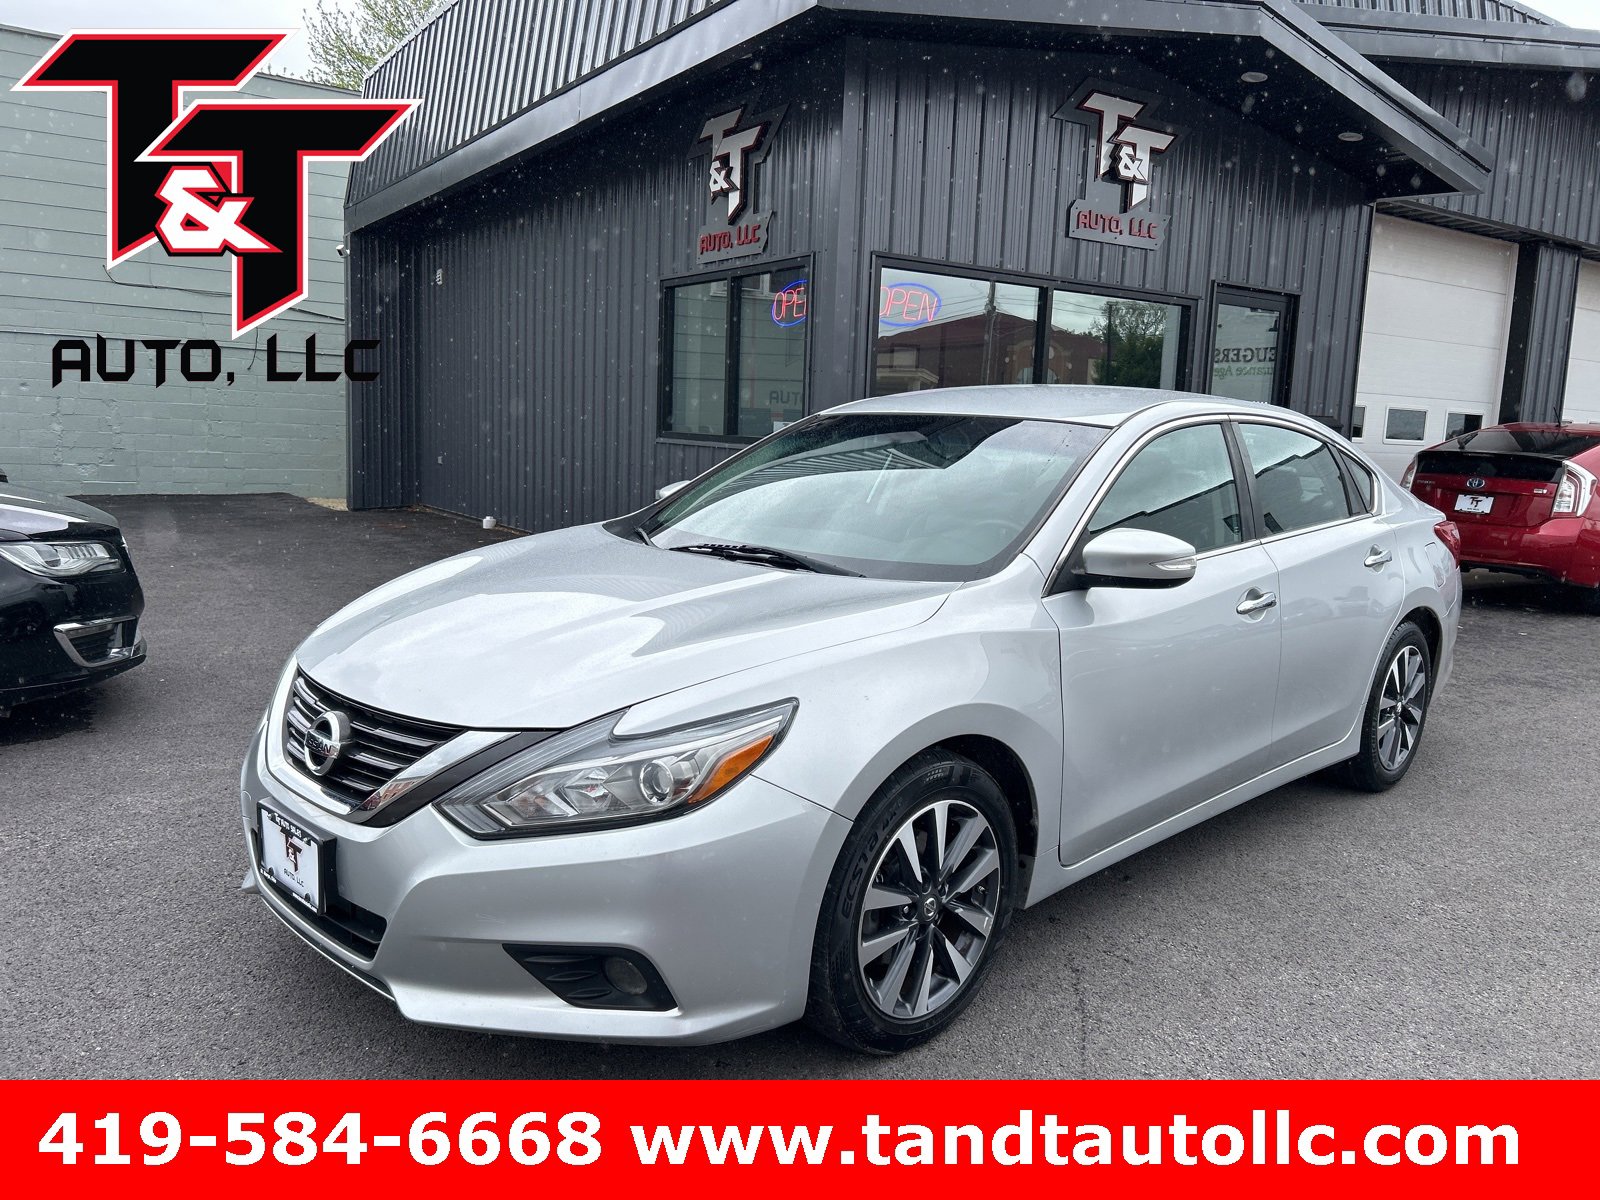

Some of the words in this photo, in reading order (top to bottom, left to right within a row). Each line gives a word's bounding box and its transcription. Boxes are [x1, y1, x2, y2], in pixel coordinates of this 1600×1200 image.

[736, 224, 761, 245] LLC
[1077, 210, 1122, 235] AUTO,
[1129, 218, 1160, 239] LLC
[769, 390, 802, 406] AUT
